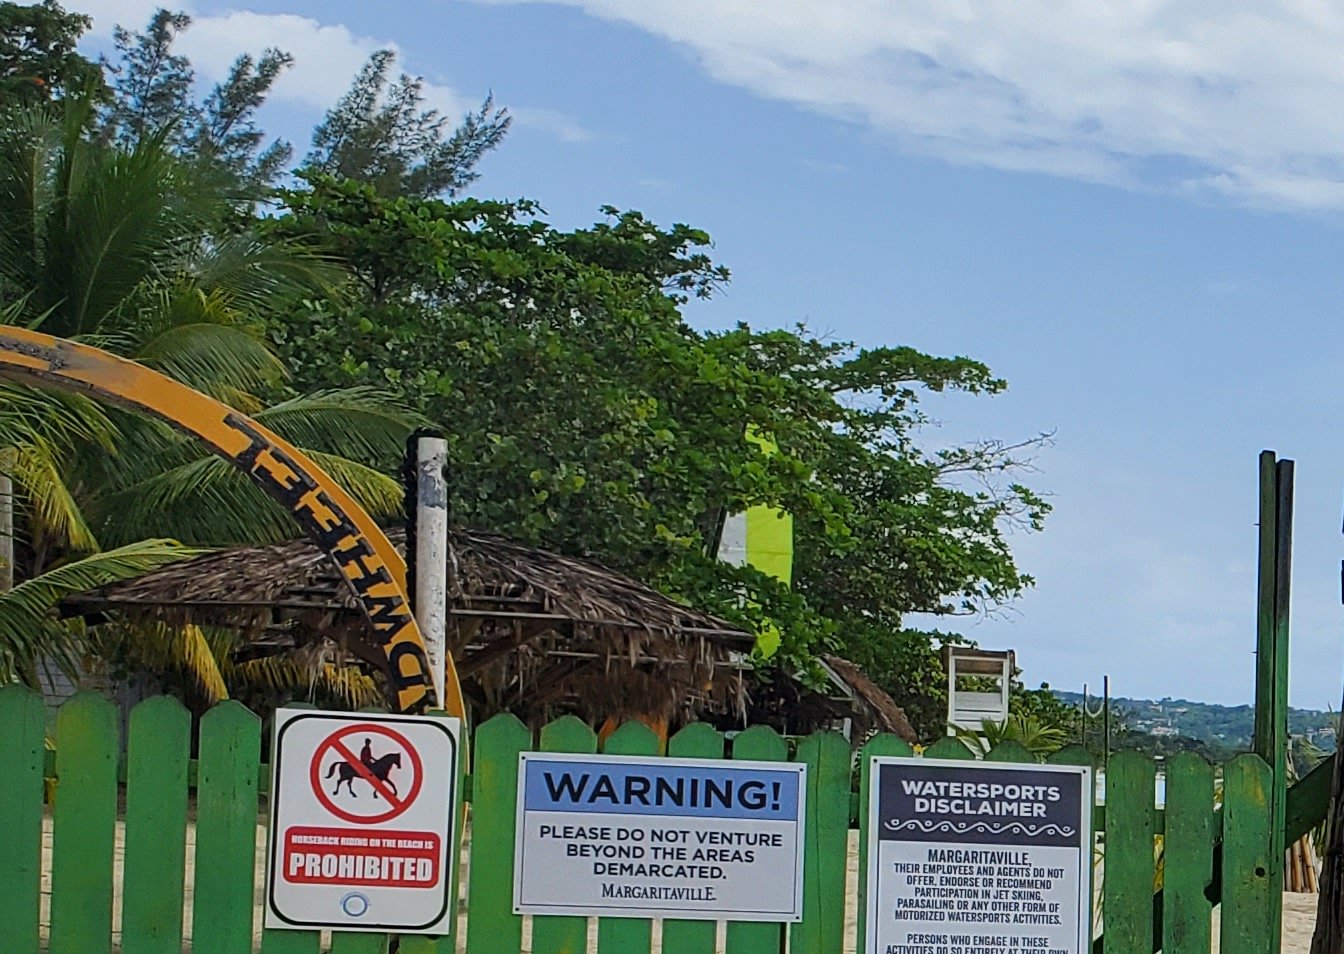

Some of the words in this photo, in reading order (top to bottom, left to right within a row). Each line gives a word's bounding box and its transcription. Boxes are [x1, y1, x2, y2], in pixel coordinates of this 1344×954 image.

[544, 772, 781, 810] WARNING!
[902, 780, 1060, 801] WATERSPORTS
[915, 799, 1046, 817] DISCLAIMER
[540, 826, 611, 840] PLEASE
[617, 829, 644, 841] DO
[651, 830, 690, 843] NOT
[696, 831, 782, 847] VENTURE
[567, 844, 644, 859] BEYOND
[651, 847, 686, 860] THE
[692, 849, 754, 863] AREAS
[928, 849, 1032, 867] MARGARITAVILLE,
[289, 853, 432, 882] PROHIBITED
[594, 863, 726, 879] DEMARCATED.
[895, 863, 920, 874] THEIR
[923, 864, 973, 875] EMPLOYEES
[977, 866, 994, 876] AND
[997, 867, 1030, 877] AGENTS
[1033, 868, 1044, 877] DO
[1048, 868, 1064, 878] NOT
[940, 876, 980, 887] ENDORSE
[982, 877, 994, 887] OR
[997, 878, 1051, 889] RECOMMEND
[915, 887, 978, 899] PARTICIPATION
[981, 889, 990, 899] IN
[993, 889, 1009, 900] JET
[898, 898, 954, 910] PARASAILING
[957, 900, 968, 910] OR
[971, 900, 989, 911] ANY
[991, 901, 1019, 912] OTHER
[1022, 902, 1046, 912] FORM
[1049, 903, 1060, 913] OF
[895, 910, 945, 921] MOTORIZED
[948, 912, 1010, 923] WATERSPORTS
[1013, 913, 1062, 925] ACTIVITIES.
[907, 934, 947, 945] PERSONS
[951, 935, 970, 946] WHO
[973, 936, 1007, 946] ENGAGE
[1010, 937, 1018, 946] IN
[1022, 937, 1048, 947] THESE
